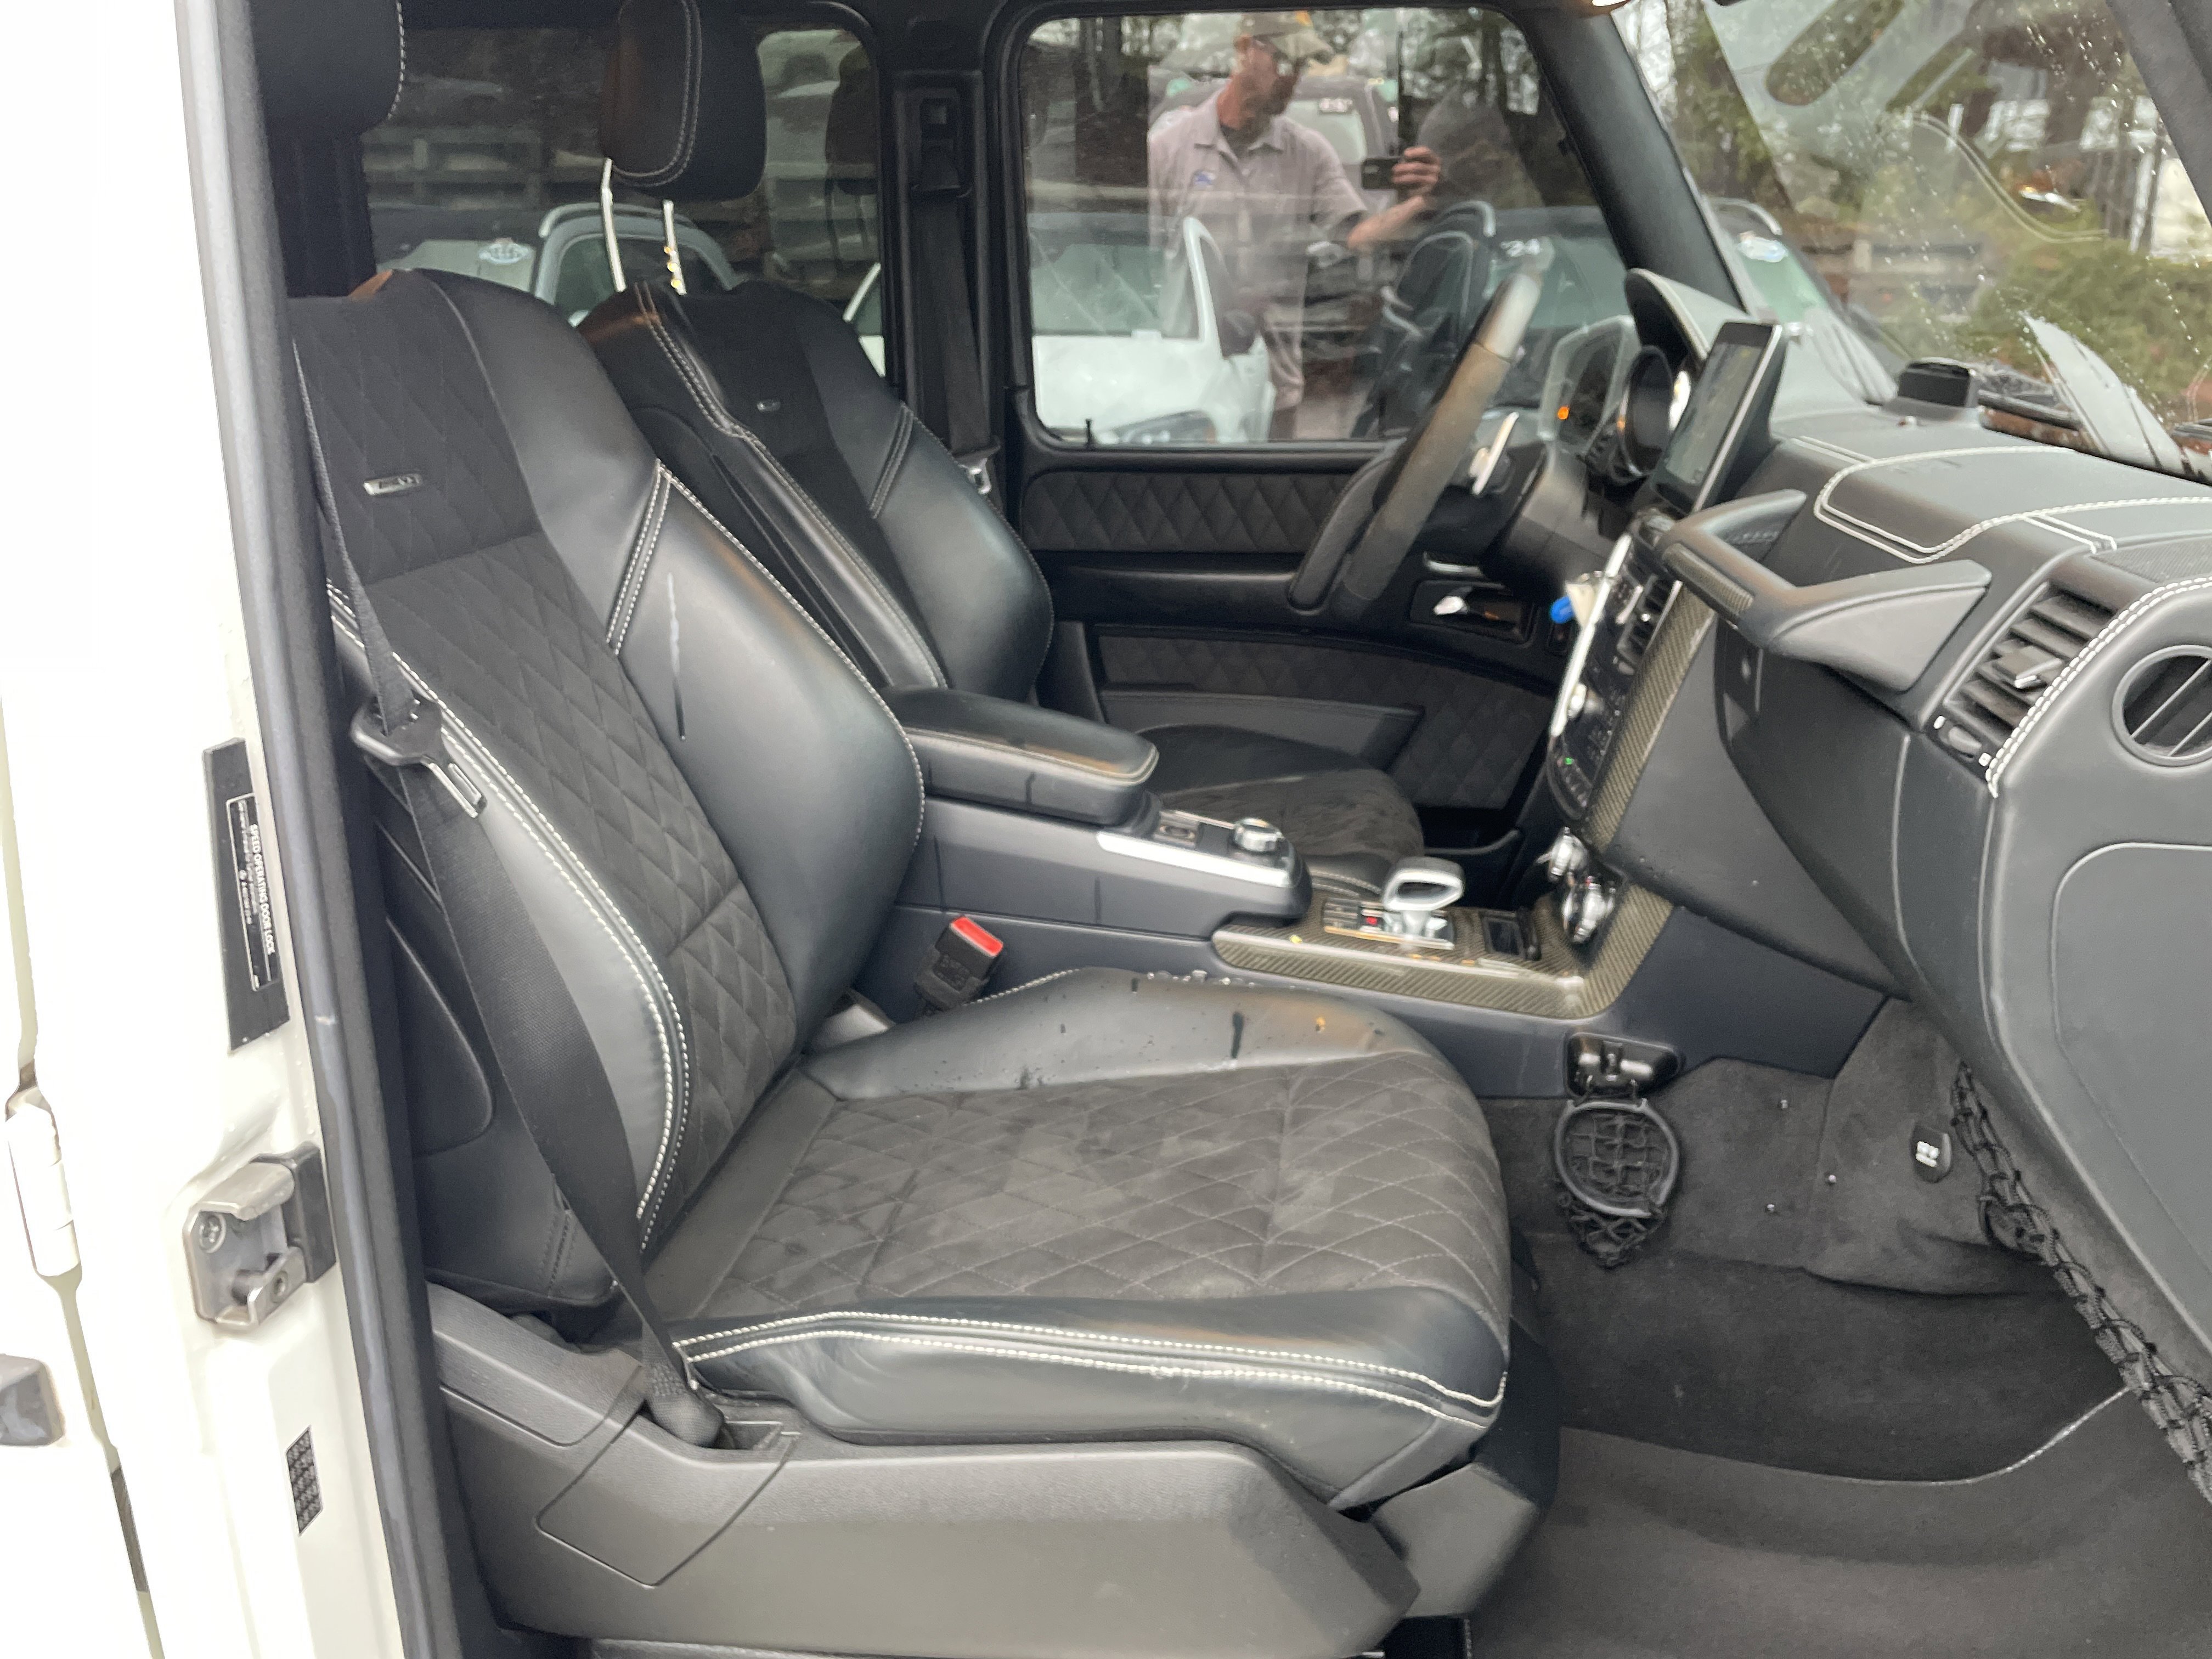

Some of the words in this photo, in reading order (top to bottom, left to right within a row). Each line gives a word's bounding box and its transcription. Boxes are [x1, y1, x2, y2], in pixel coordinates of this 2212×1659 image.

[250, 823, 261, 854] SPEED
[254, 854, 268, 904] OPERATING
[261, 902, 272, 930] DOOR
[264, 929, 275, 956] LOCK
